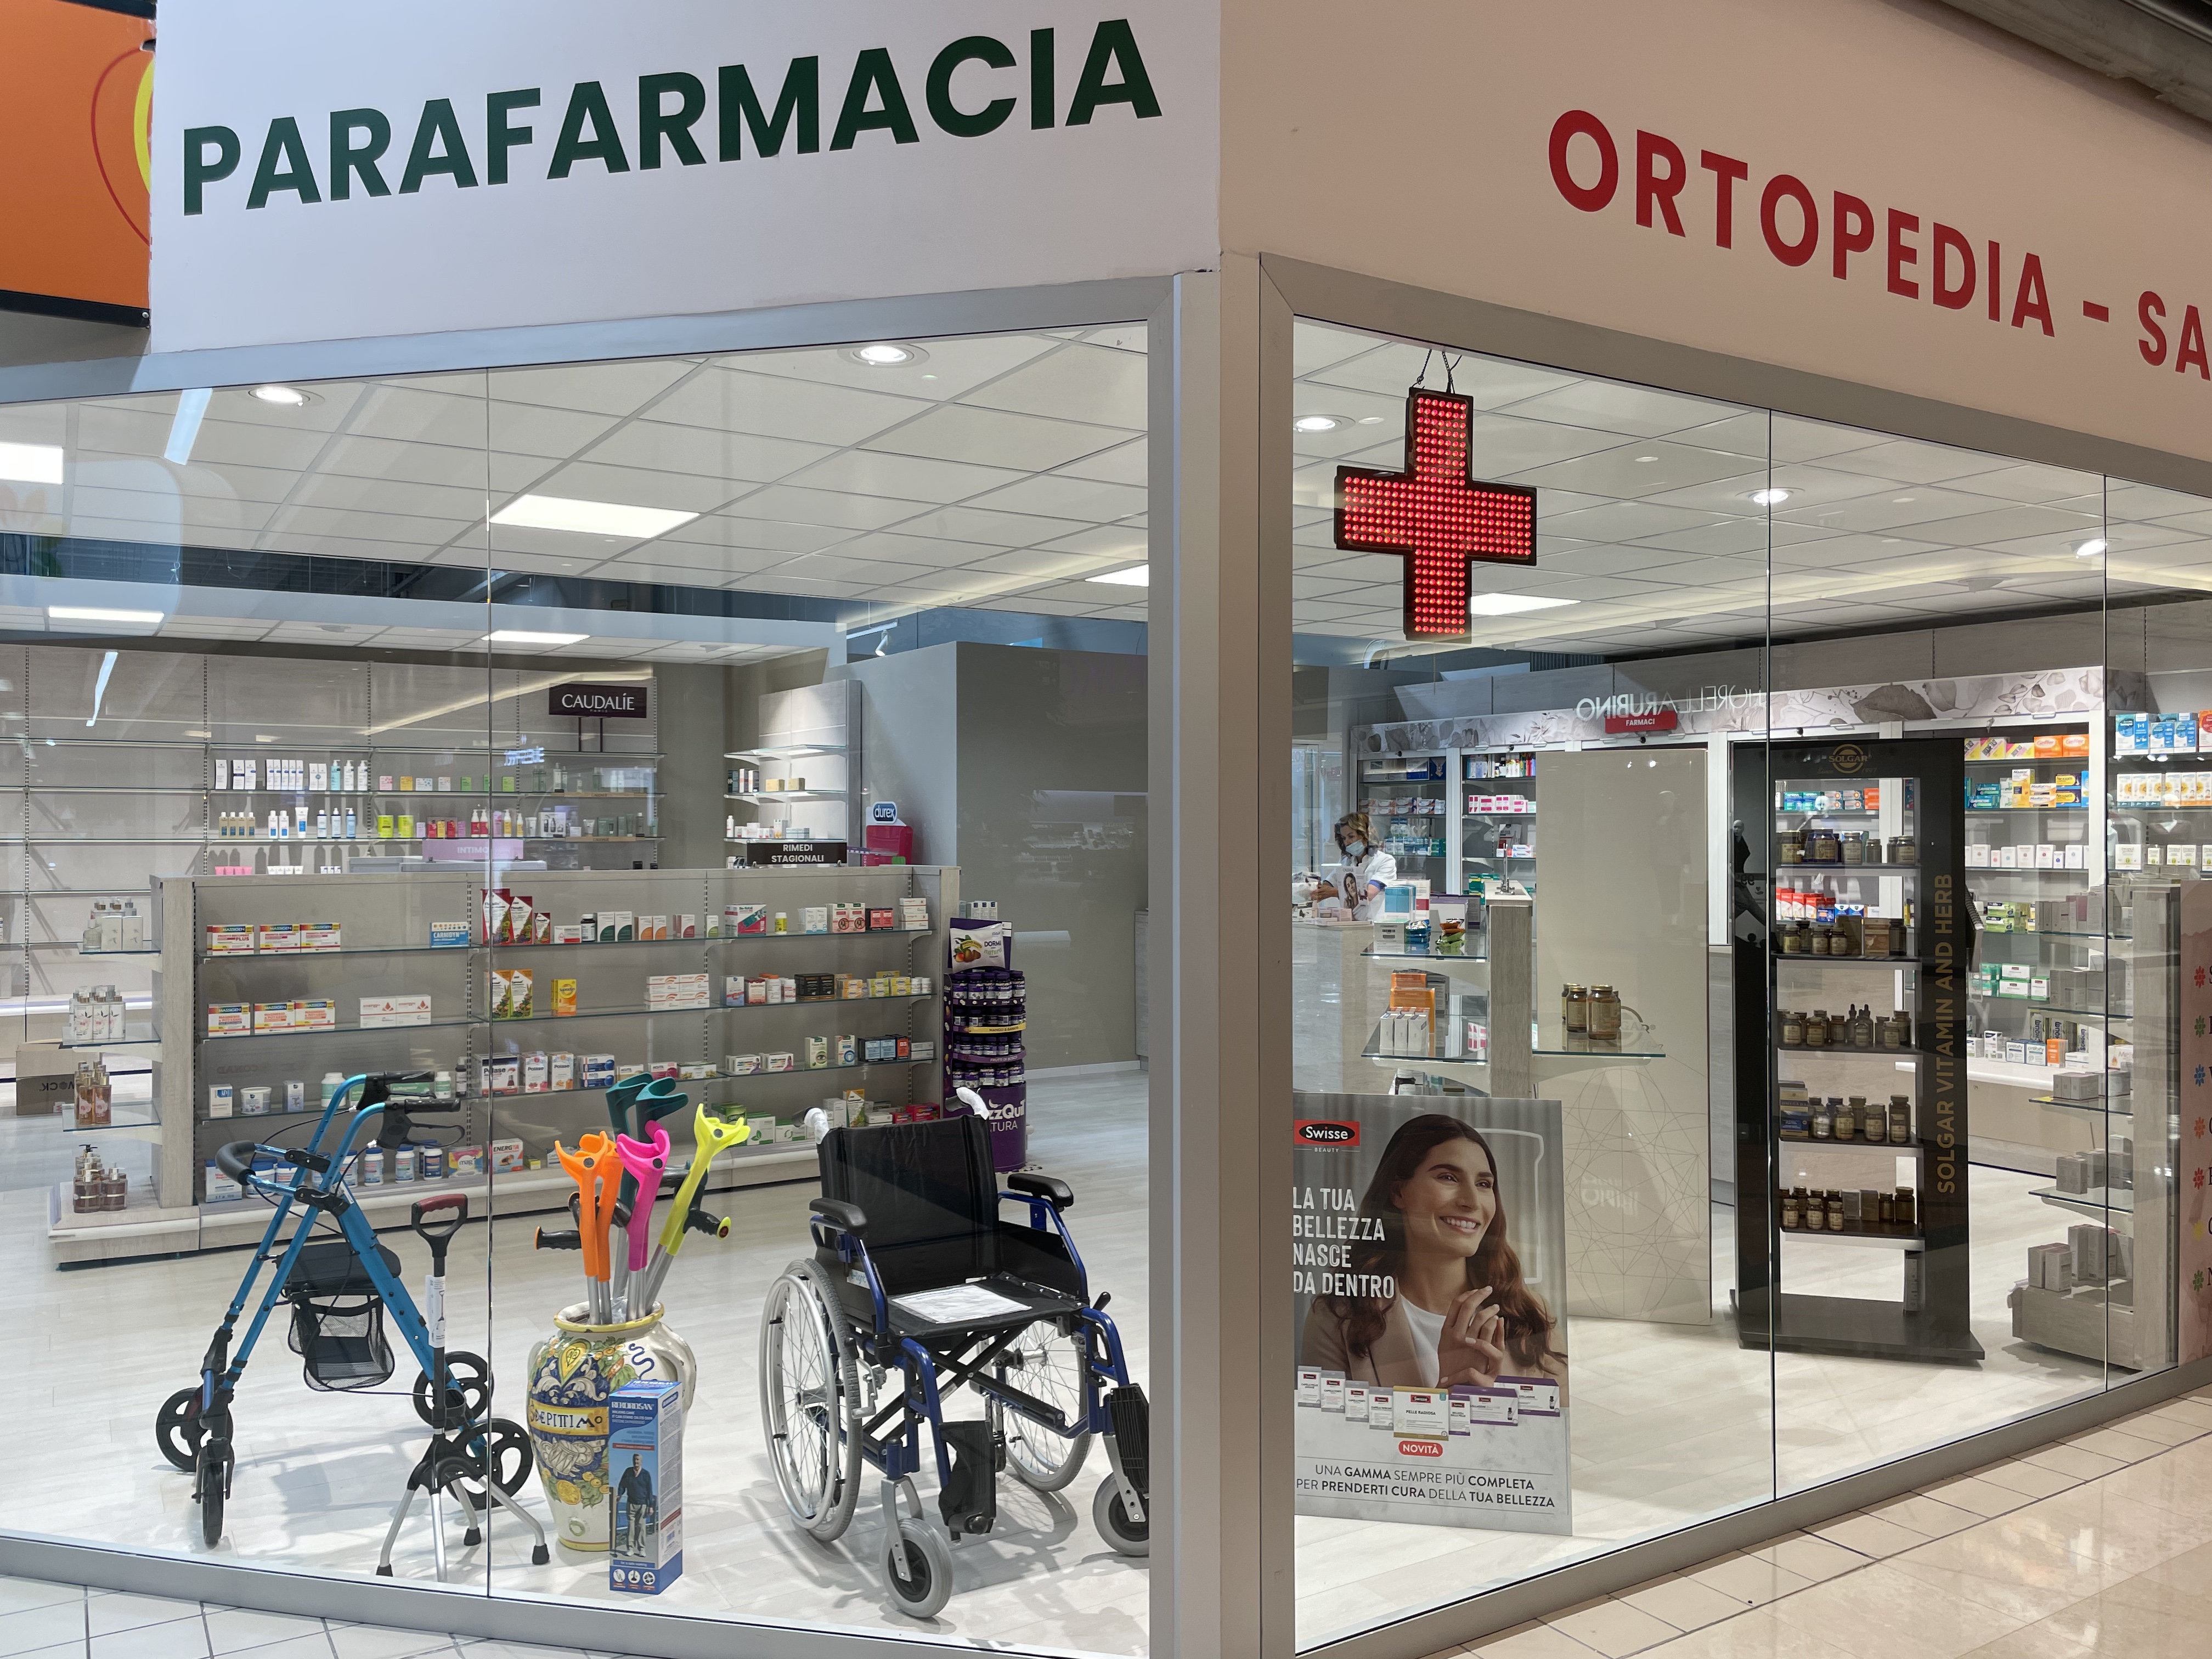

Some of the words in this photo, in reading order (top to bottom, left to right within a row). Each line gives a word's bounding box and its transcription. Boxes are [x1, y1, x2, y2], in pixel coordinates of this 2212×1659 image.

[183, 19, 1163, 216] PARAFARMACIA
[1549, 110, 2056, 338] ORTOPEDIA
[2138, 290, 2211, 381] SA
[562, 693, 635, 710] CAUDALÍE
[1626, 718, 1655, 726] FARMACI
[874, 804, 895, 818] durex
[457, 846, 489, 854] INTIMO
[771, 854, 824, 863] STAGIONALI
[782, 844, 813, 852] RIMEDI
[1934, 874, 1952, 934] HERB
[1934, 941, 1953, 991] AND
[1936, 998, 1954, 1094] VITAMIN
[989, 1099, 1025, 1120] zzQuil
[990, 1120, 1018, 1132] TURA
[1306, 1126, 1348, 1140] Swisse
[1937, 1100, 1955, 1194] SOLGAR
[1293, 1187, 1314, 1210] LA
[1320, 1188, 1356, 1211] TUA
[1293, 1215, 1386, 1242] BELLEZZA
[1293, 1243, 1352, 1268] NASCE
[1293, 1271, 1316, 1295] DA
[1322, 1273, 1395, 1299] DENTRO
[1402, 1442, 1439, 1455] NOVITÀ
[1315, 1464, 1342, 1477] UNA
[1344, 1466, 1391, 1480] GAMMA
[1394, 1470, 1442, 1484] SEMPRE
[1445, 1471, 1465, 1486] PIÙ
[1468, 1475, 1535, 1491] COMPLETA
[1296, 1478, 1318, 1490] PER
[1322, 1481, 1389, 1496] PRENDERTI
[1391, 1486, 1426, 1499] CURA
[1429, 1488, 1467, 1502] DELLA
[1469, 1491, 1494, 1504] TUA
[1497, 1493, 1555, 1508] BELLEZZA
